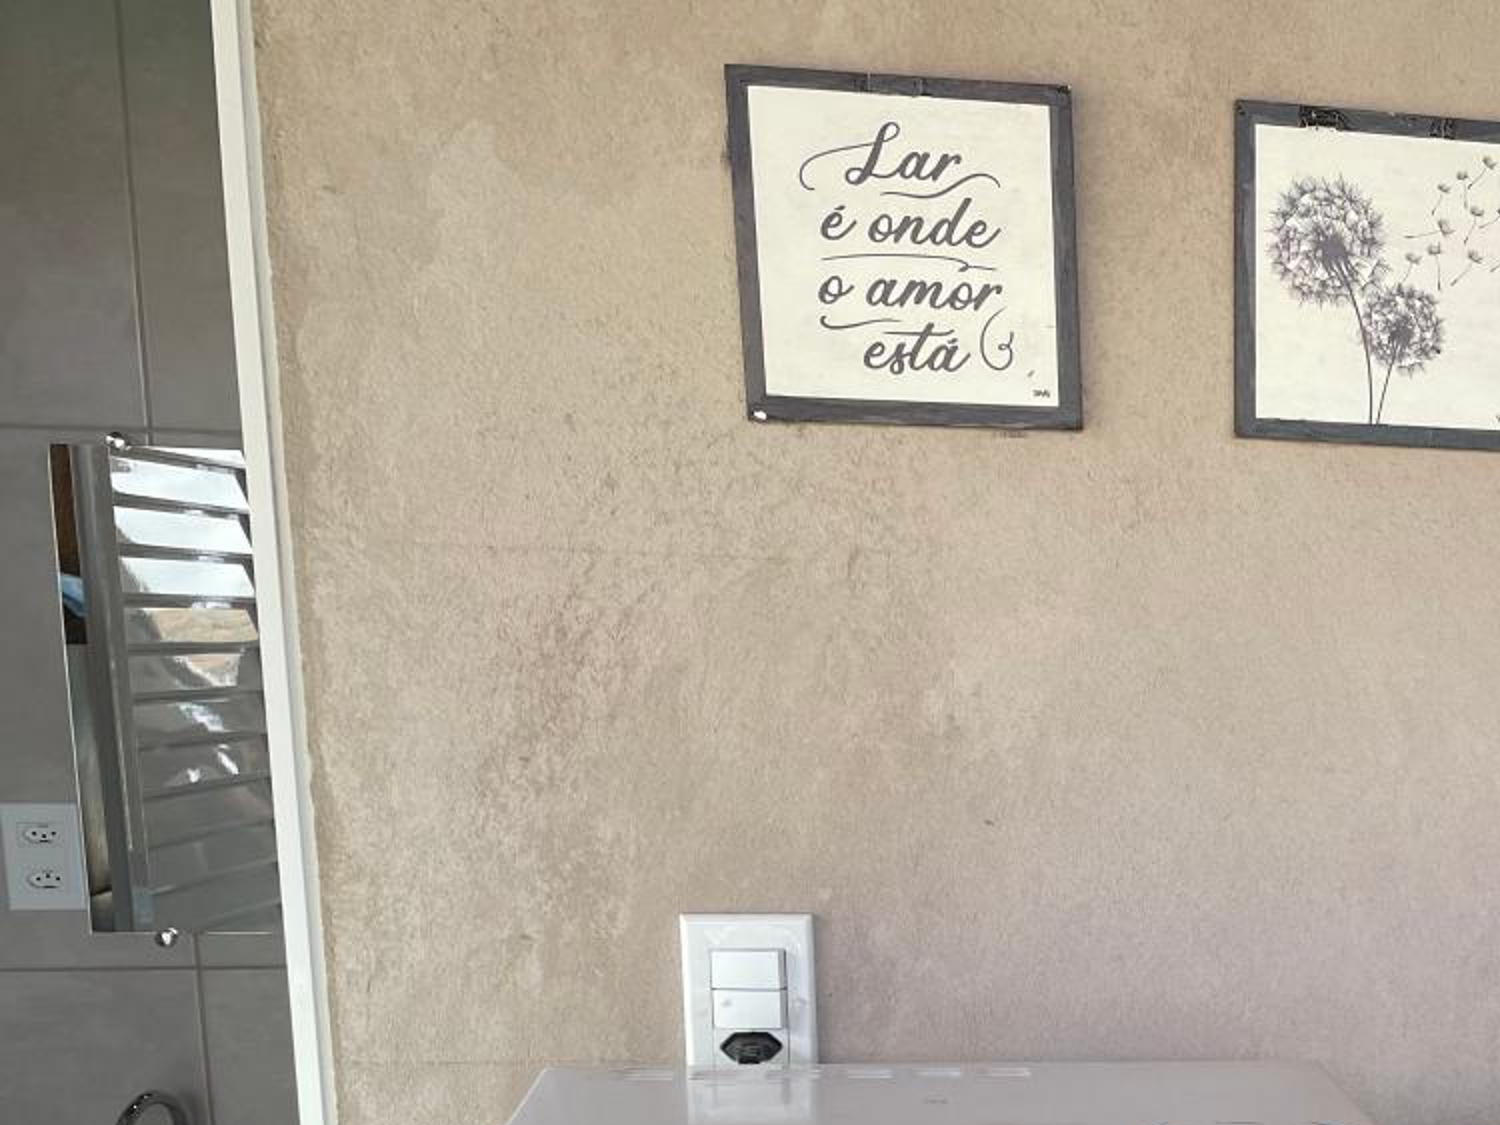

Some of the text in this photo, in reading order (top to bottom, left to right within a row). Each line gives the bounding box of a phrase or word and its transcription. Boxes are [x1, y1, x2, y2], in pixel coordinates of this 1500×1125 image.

[800, 121, 963, 190] Lar
[820, 198, 1001, 248] é onde
[818, 275, 1003, 311] o amor
[863, 322, 970, 375] está
